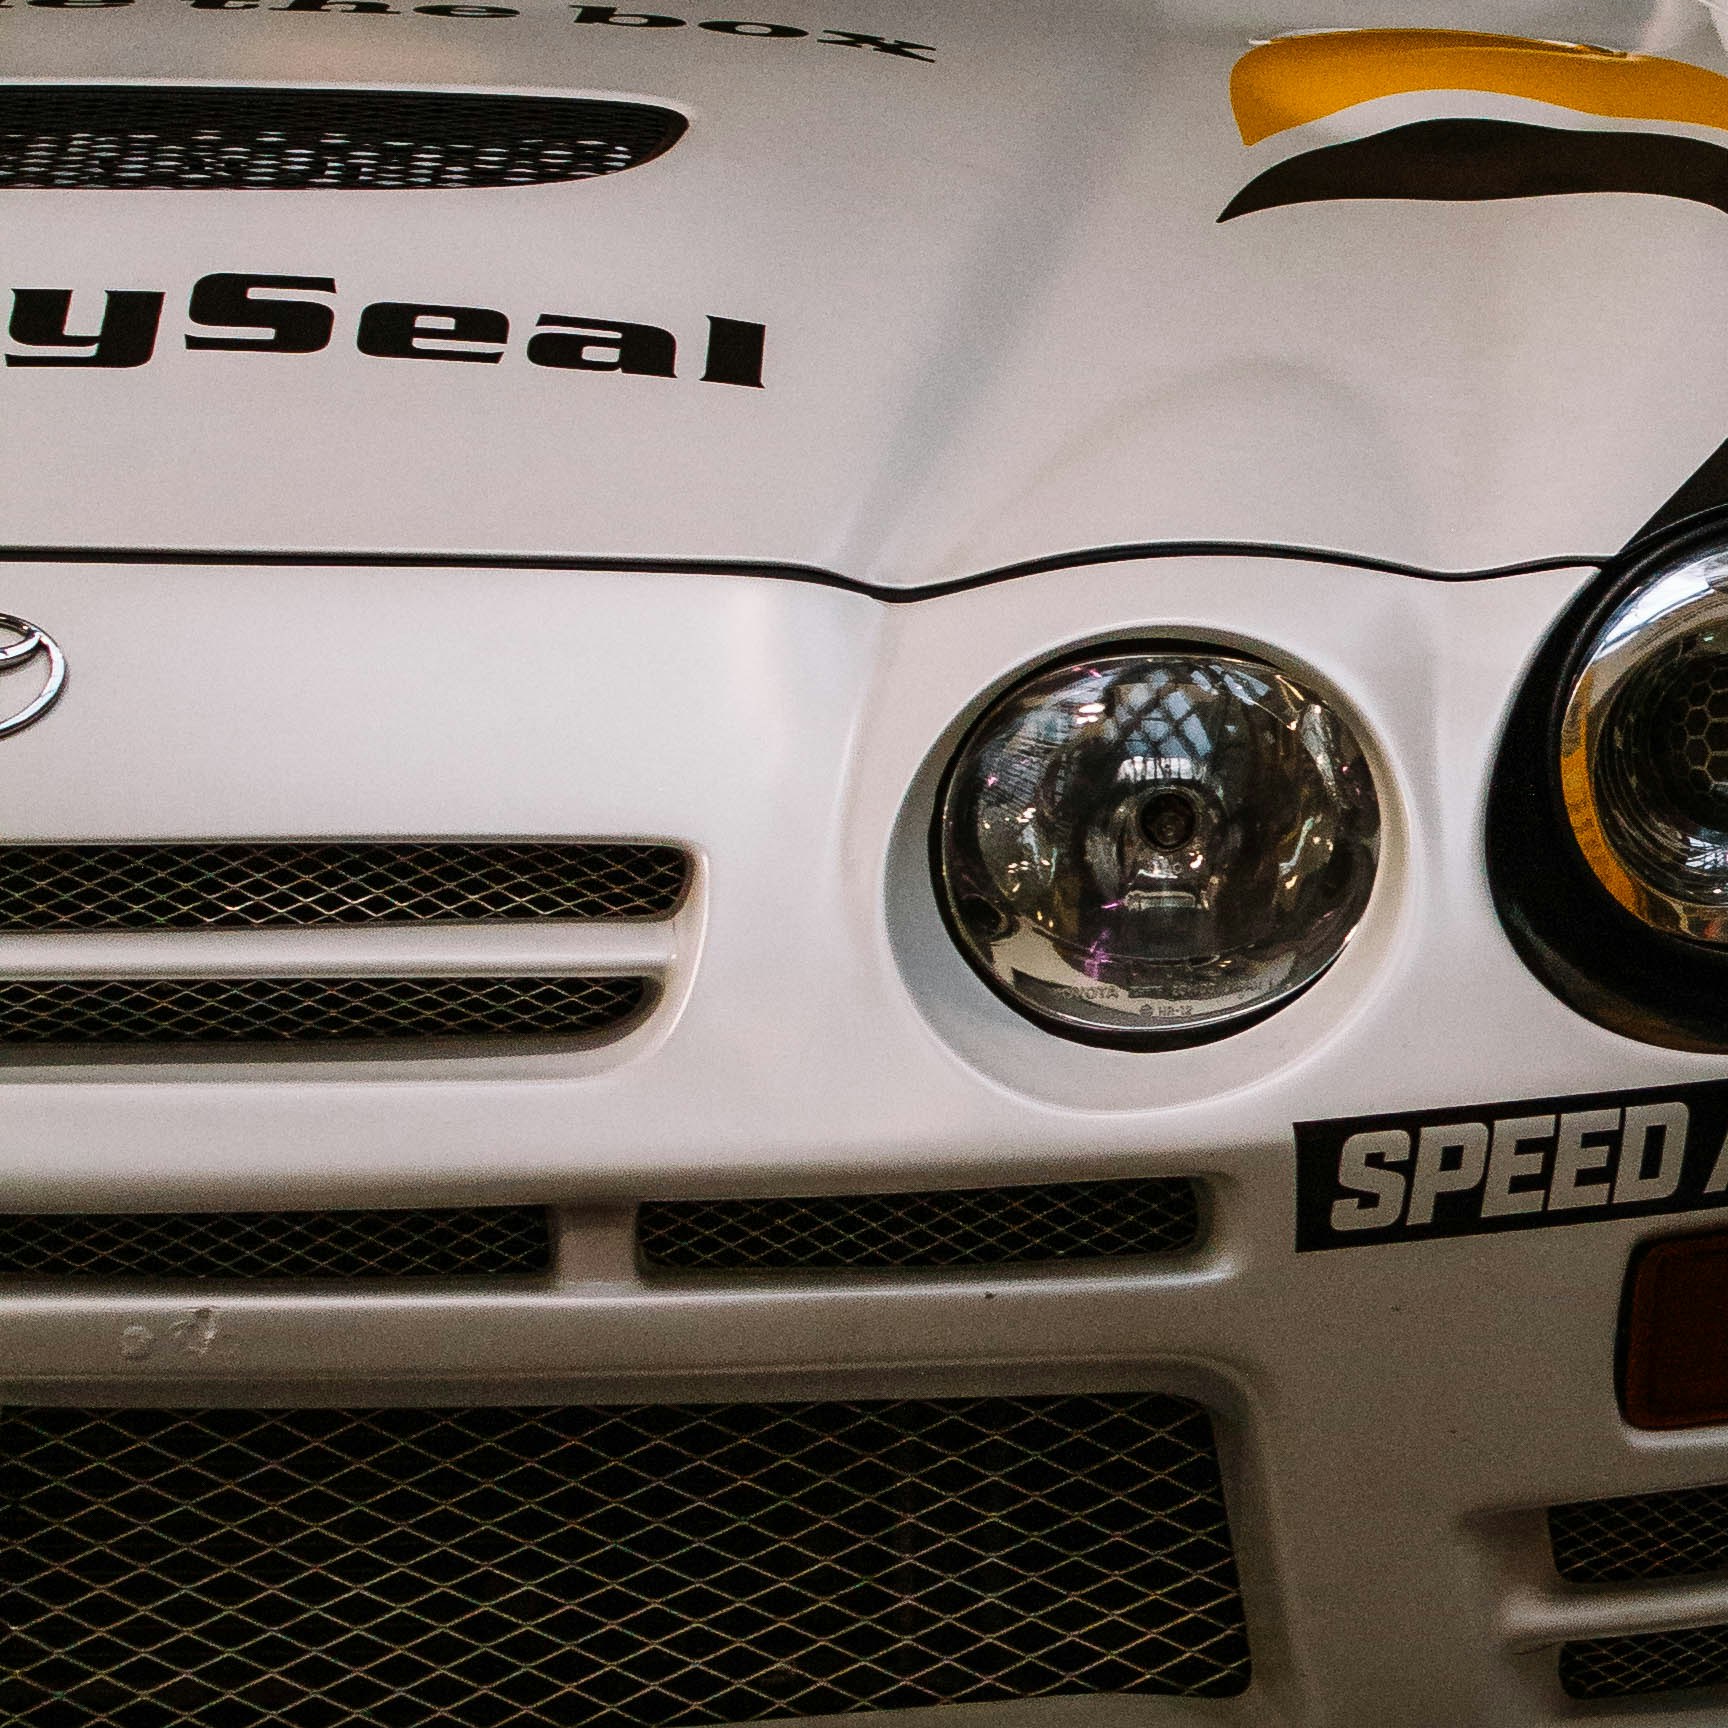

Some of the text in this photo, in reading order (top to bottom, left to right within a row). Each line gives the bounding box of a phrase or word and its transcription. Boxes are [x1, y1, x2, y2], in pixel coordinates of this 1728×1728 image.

[570, 5, 936, 62] box
[4, 272, 766, 389] ySeal
[1330, 1100, 1690, 1232] SPEED
